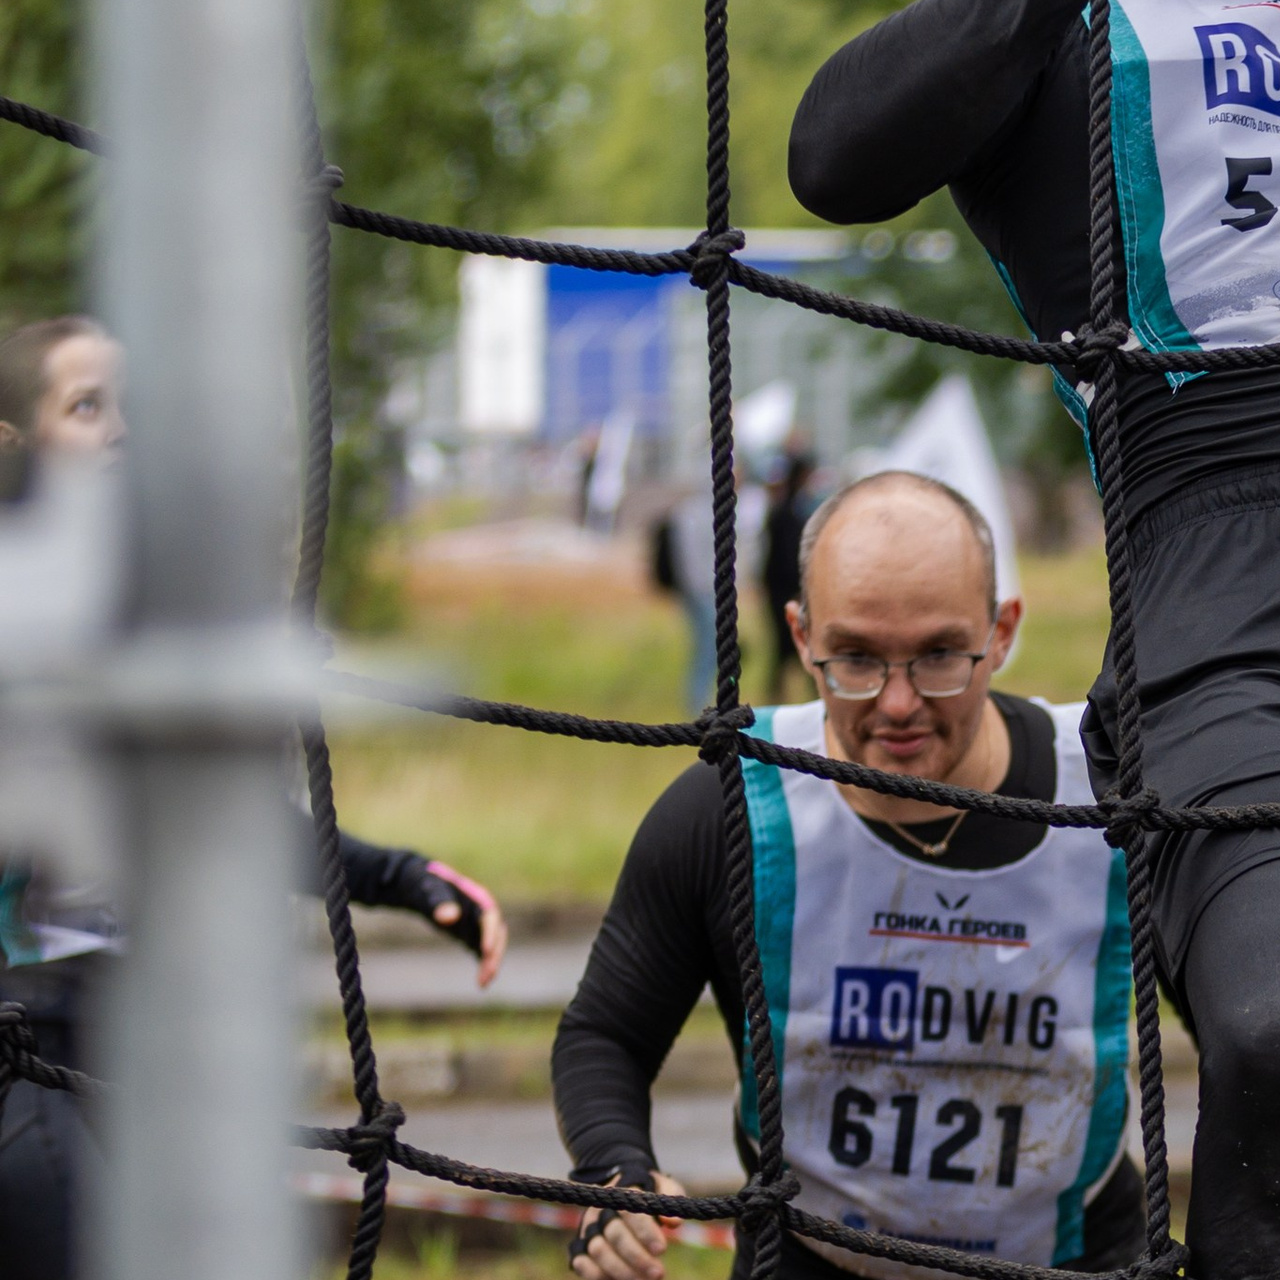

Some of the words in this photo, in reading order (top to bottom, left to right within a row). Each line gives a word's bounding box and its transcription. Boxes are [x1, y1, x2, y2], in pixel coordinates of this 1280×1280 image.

[1208, 112, 1257, 130] НАДЕЖНОСТЬ
[873, 912, 942, 934] ГОНКА
[948, 918, 1027, 941] ГЕРОЕВ
[839, 978, 1059, 1051] RODVIG
[828, 1085, 1024, 1189] 6121
